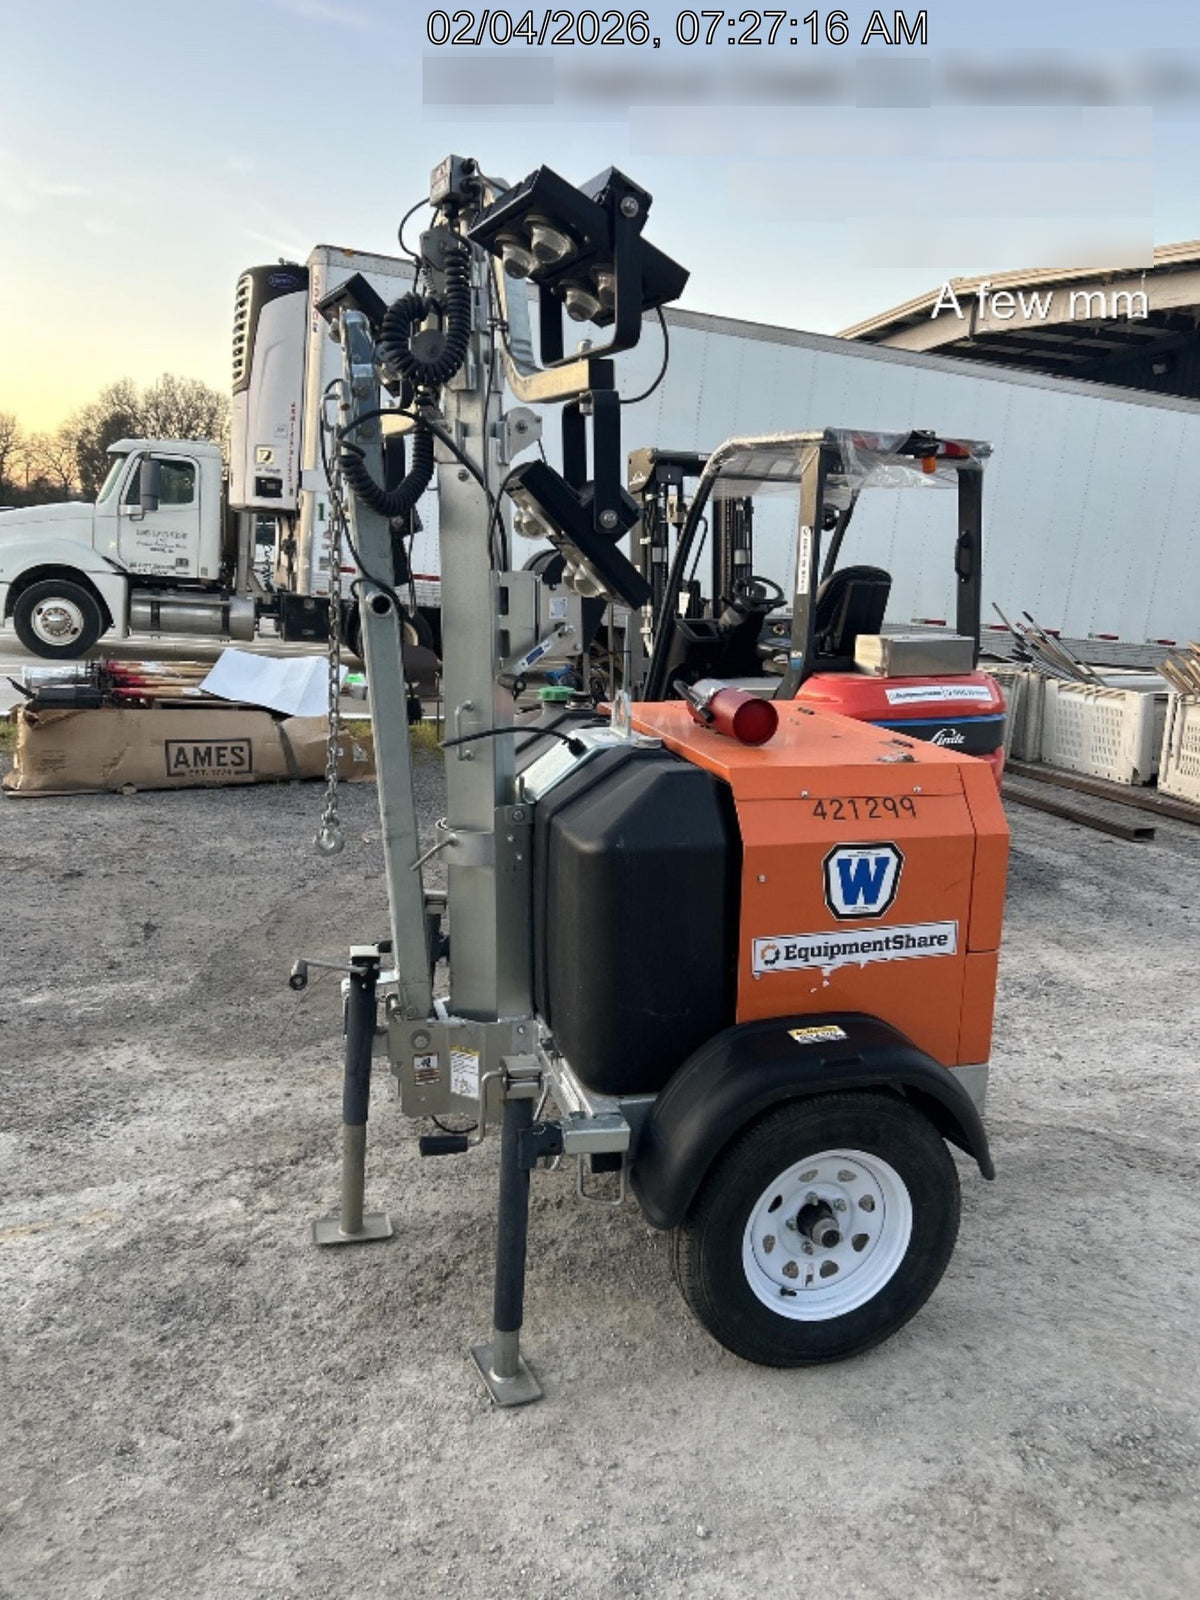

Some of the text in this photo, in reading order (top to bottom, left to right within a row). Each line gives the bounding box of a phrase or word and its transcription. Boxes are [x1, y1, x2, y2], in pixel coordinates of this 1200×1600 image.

[173, 745, 246, 768] AMES
[812, 796, 917, 821] 421299
[836, 856, 890, 906] W
[783, 933, 949, 963] EquipmentShare
